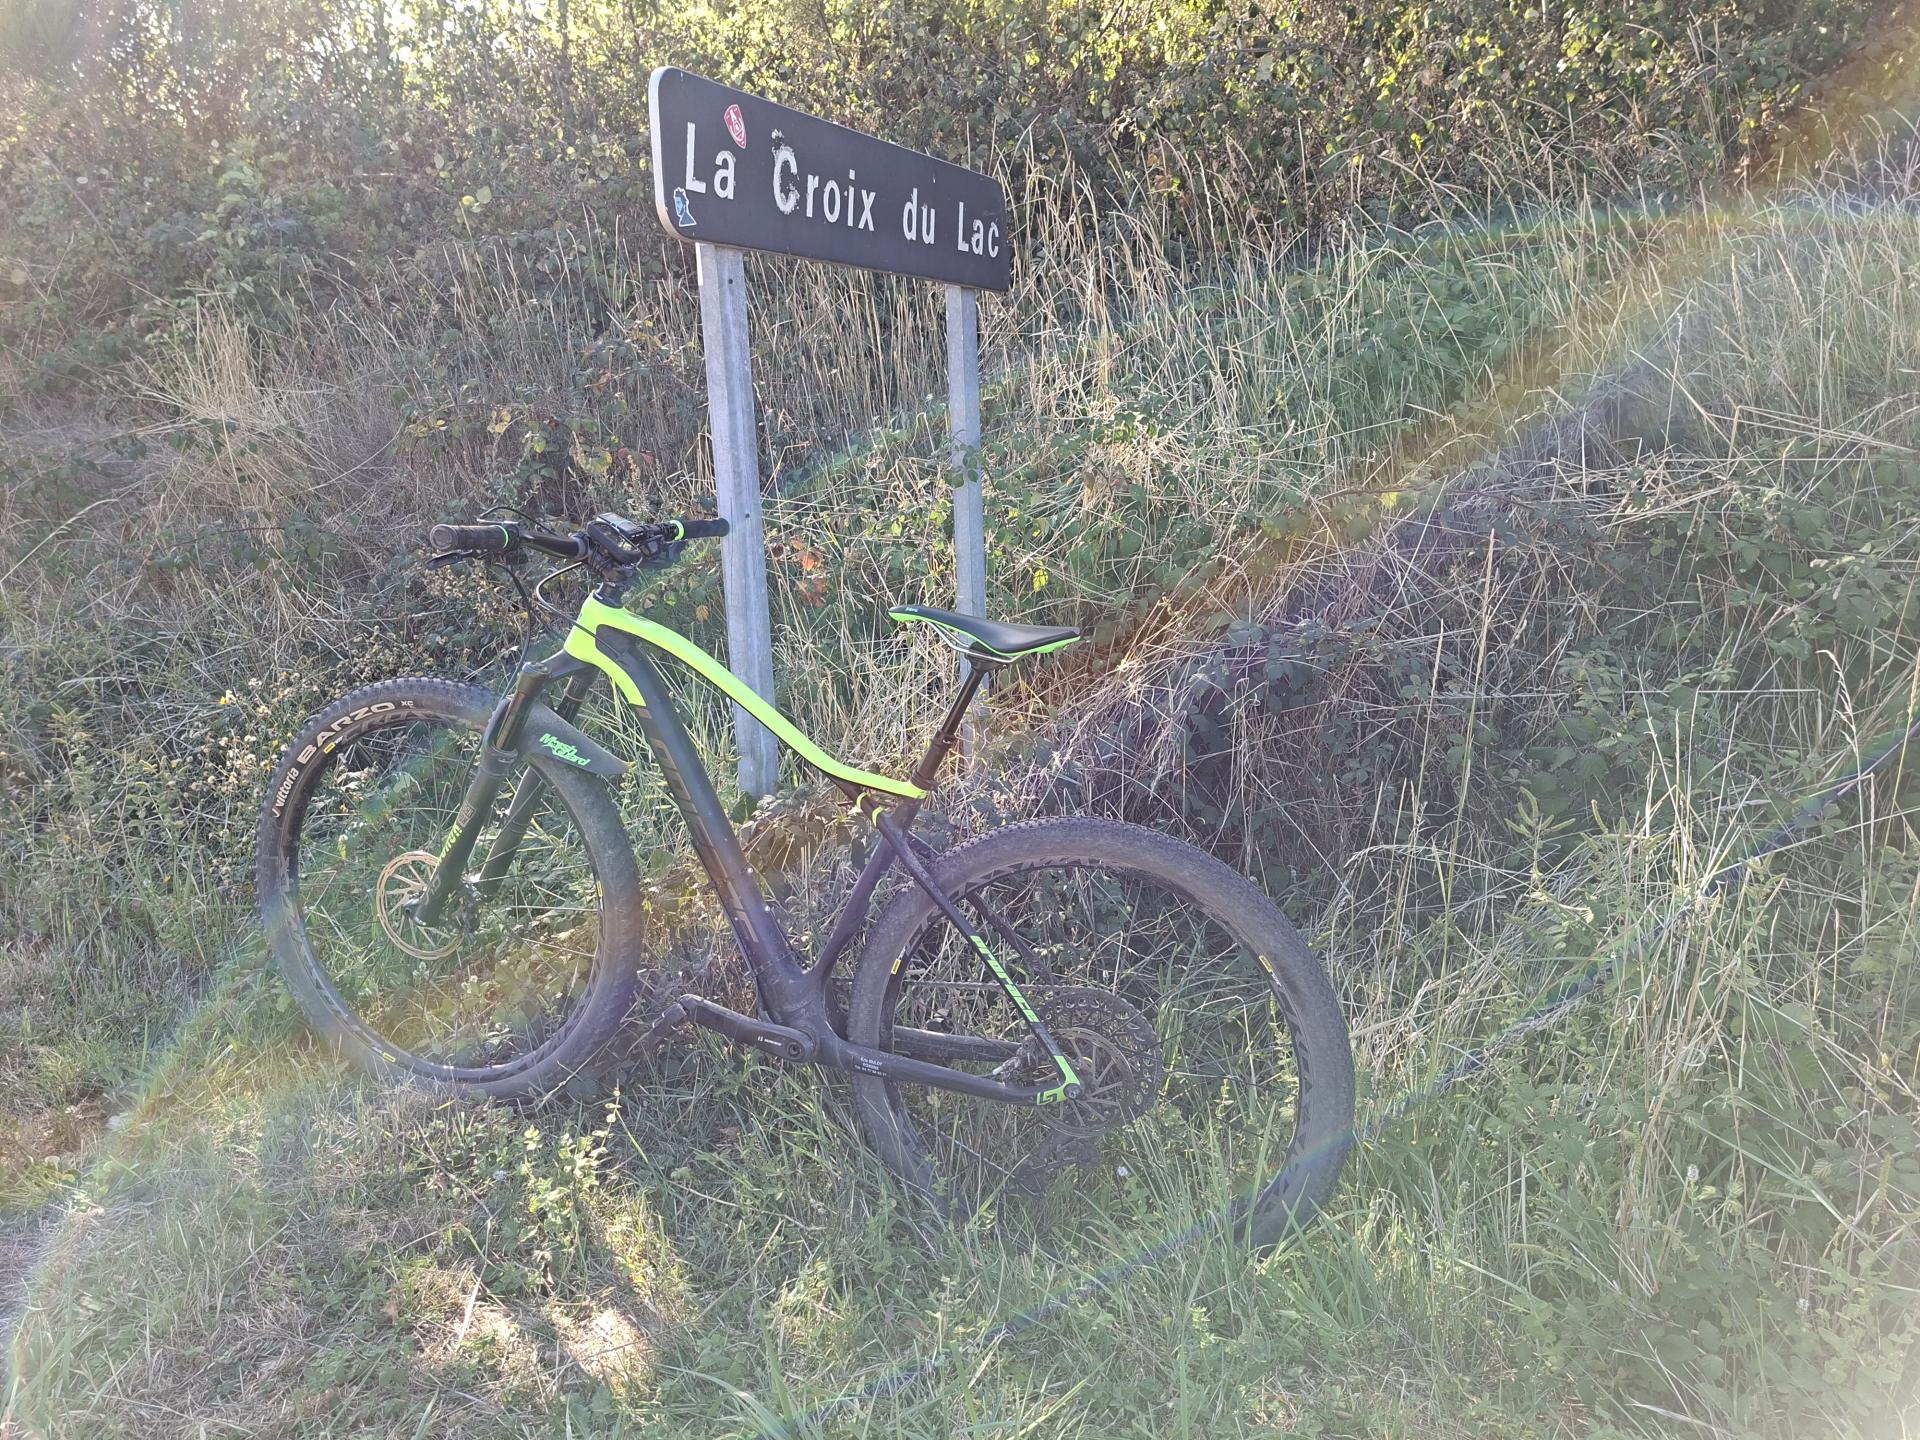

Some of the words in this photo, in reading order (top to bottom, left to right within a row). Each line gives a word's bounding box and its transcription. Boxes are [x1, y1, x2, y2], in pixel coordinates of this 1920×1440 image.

[685, 121, 736, 200] La
[771, 148, 876, 231] Croix
[903, 187, 935, 245] du
[957, 201, 999, 258] Lac
[297, 702, 395, 764] BARZO
